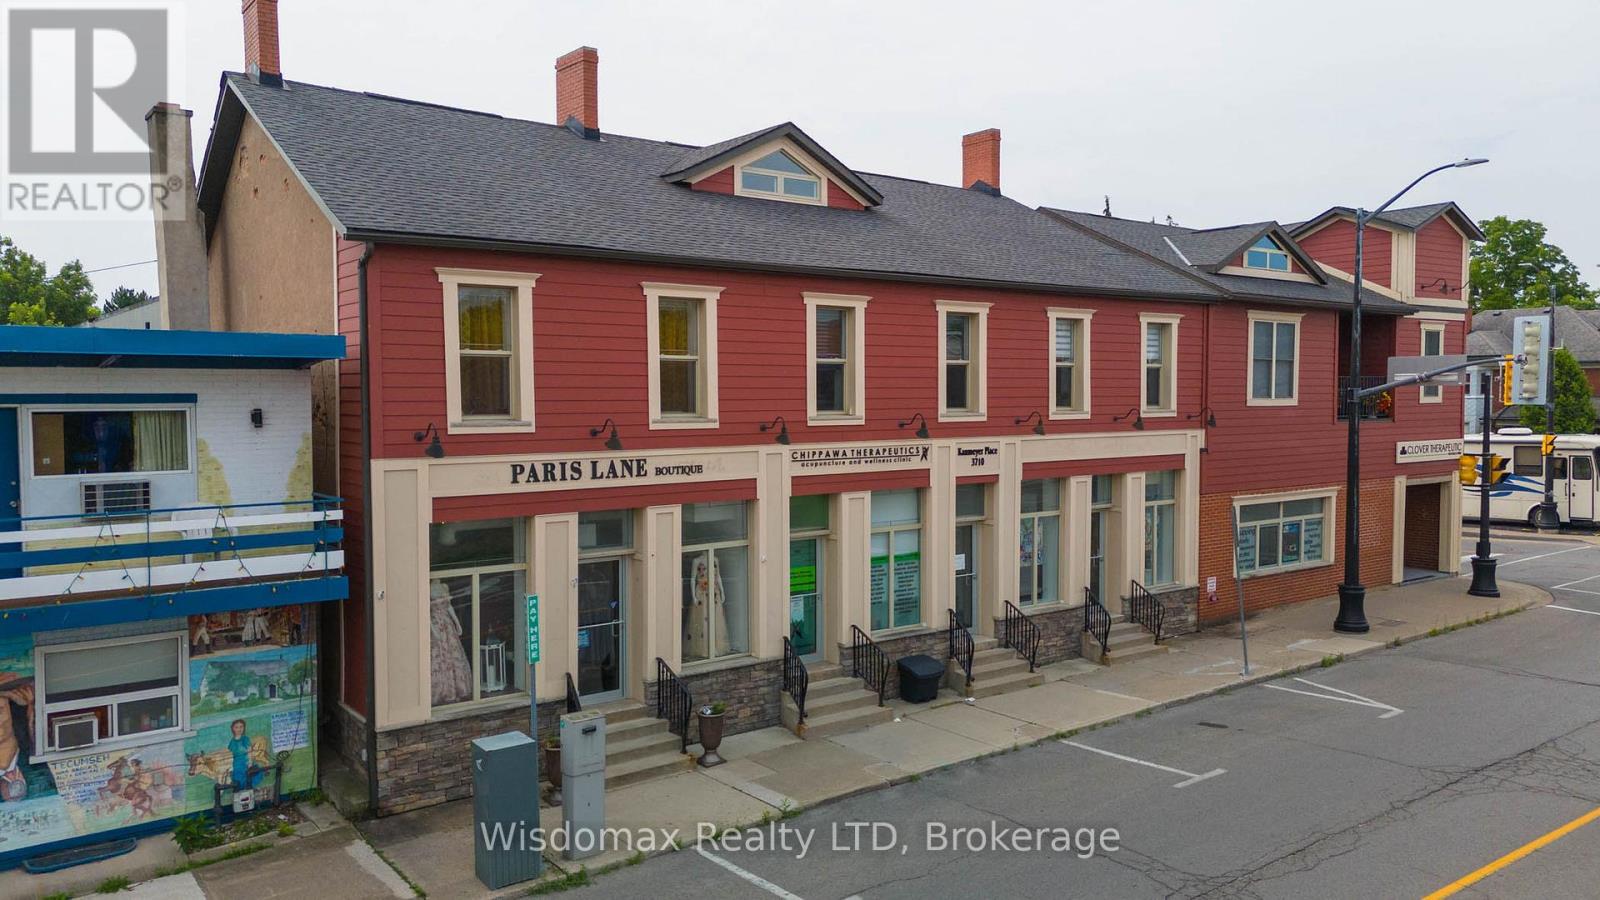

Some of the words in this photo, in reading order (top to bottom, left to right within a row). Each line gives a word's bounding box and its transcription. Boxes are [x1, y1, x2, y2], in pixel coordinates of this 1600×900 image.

[791, 449, 848, 460] CHIPPAWA
[851, 446, 920, 457] THERAPEUTICS
[1407, 444, 1430, 455] CLOVER
[801, 460, 846, 468] acupuncture
[971, 457, 985, 466] 3710
[510, 460, 583, 484] PARIS
[590, 458, 648, 480] LANE
[655, 464, 704, 477] BOUTIQUE
[529, 599, 538, 622] PAY
[530, 626, 539, 658] HERE
[50, 753, 110, 770] TECUMSEH
